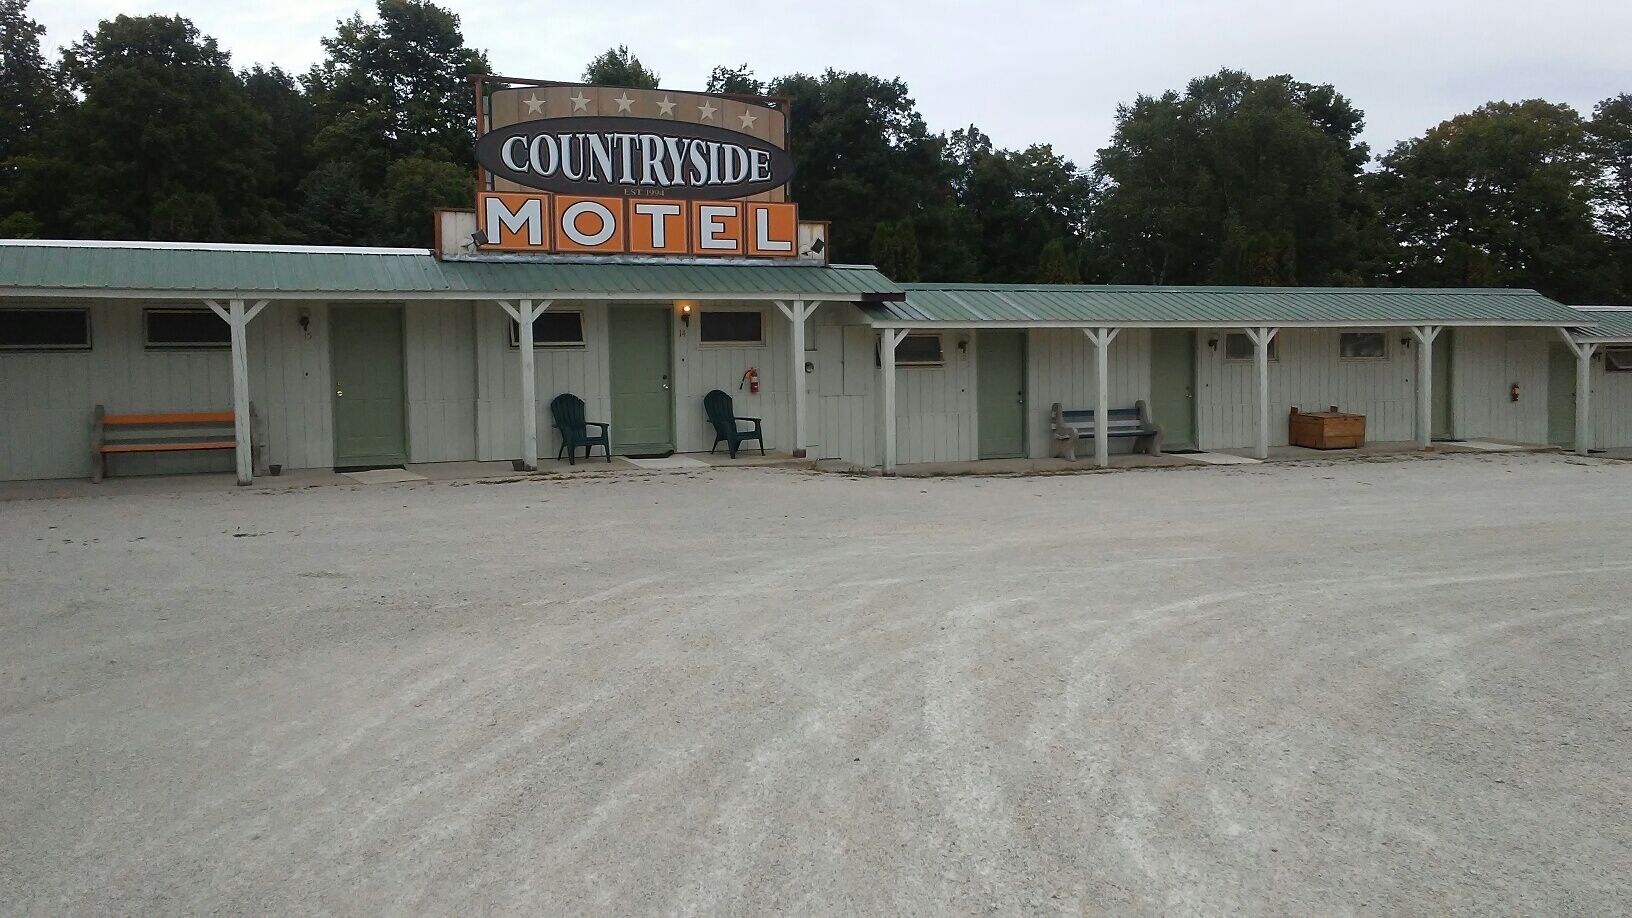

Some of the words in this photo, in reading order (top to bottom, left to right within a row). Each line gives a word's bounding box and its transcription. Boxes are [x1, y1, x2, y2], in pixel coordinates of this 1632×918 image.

[501, 132, 772, 187] COUNTRYSIDE
[624, 188, 641, 196] EST
[646, 189, 665, 197] 1994
[485, 197, 793, 252] MOTEL
